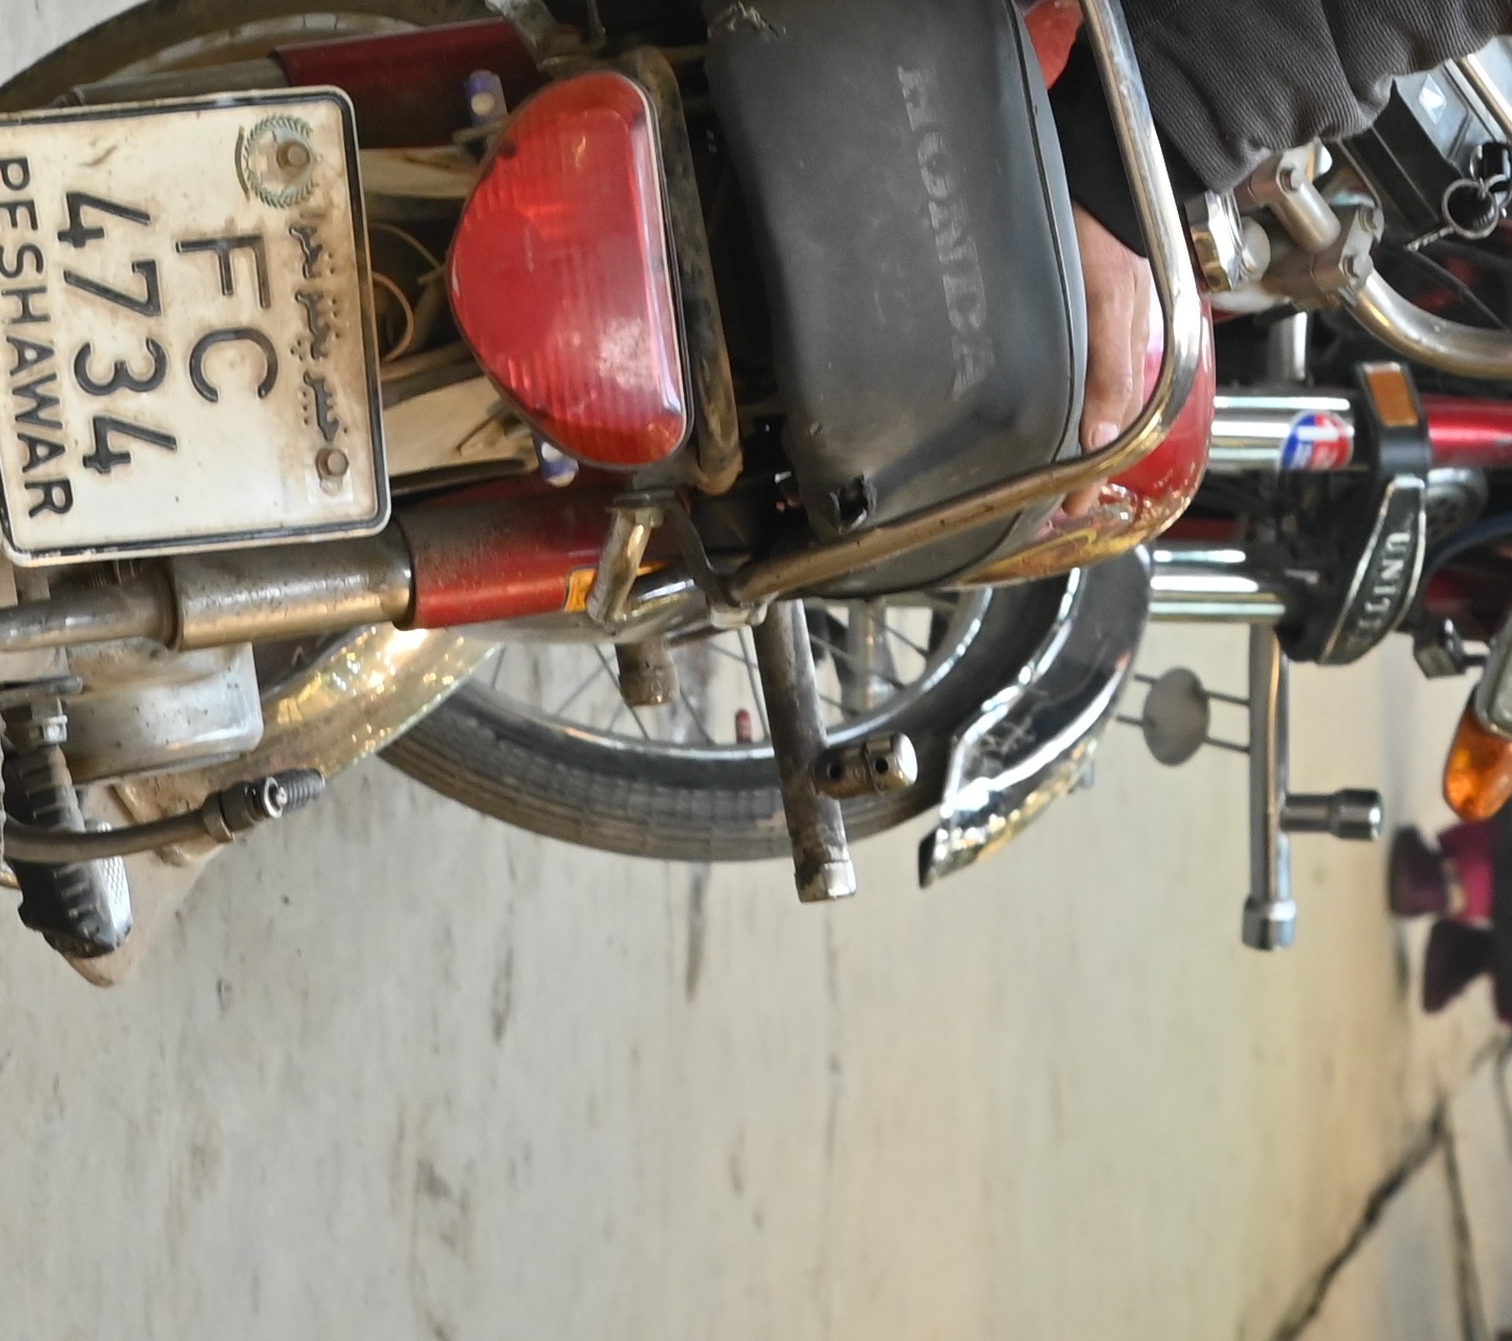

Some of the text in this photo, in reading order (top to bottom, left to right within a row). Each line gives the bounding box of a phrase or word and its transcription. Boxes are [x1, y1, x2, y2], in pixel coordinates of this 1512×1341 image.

[55, 191, 180, 476] 4734
[174, 233, 280, 404] FC
[896, 66, 998, 401] HONDA
[1343, 530, 1411, 659] UNIT
